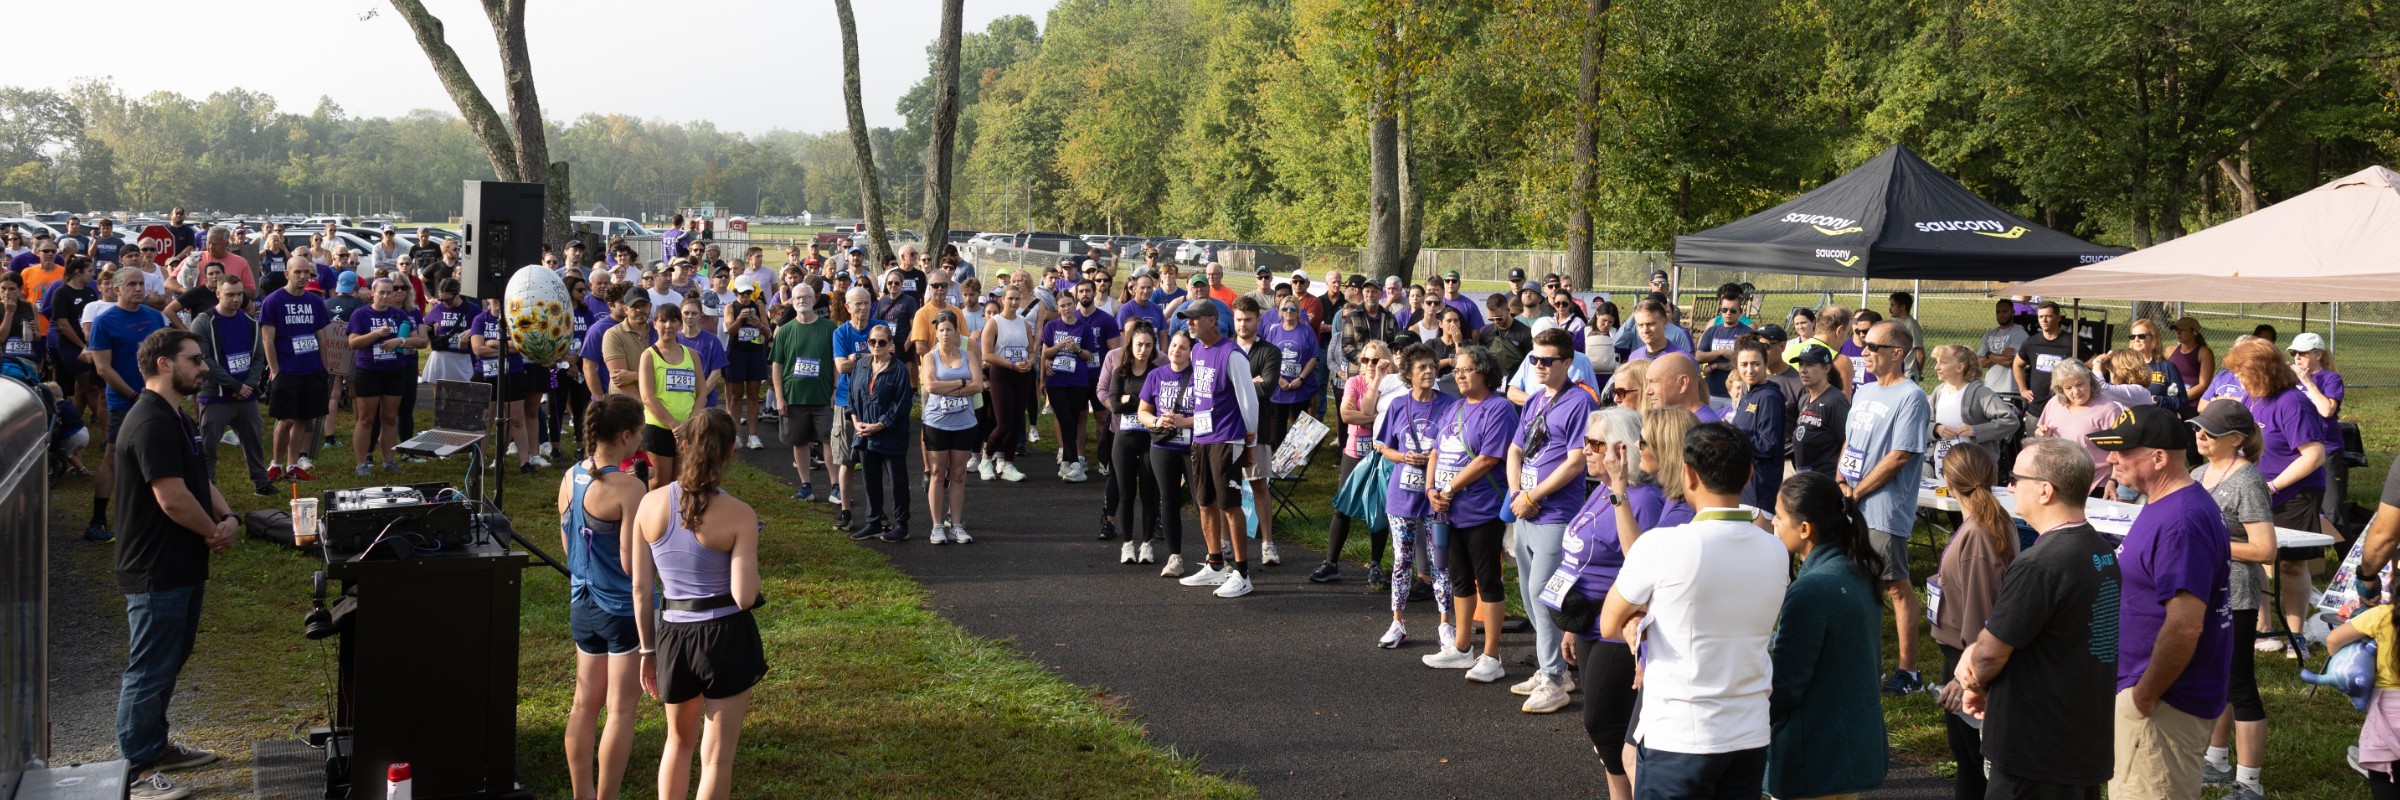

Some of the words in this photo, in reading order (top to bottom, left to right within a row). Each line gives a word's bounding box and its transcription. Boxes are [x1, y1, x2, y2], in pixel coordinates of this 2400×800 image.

[1781, 212, 1856, 228] saucony
[1914, 219, 2004, 232] saucony
[1815, 248, 1851, 261] saucony
[2080, 255, 2117, 264] saucon
[326, 340, 352, 351] ARKIN
[798, 363, 816, 372] 1224
[671, 375, 692, 385] 1281
[944, 397, 964, 408] 1271
